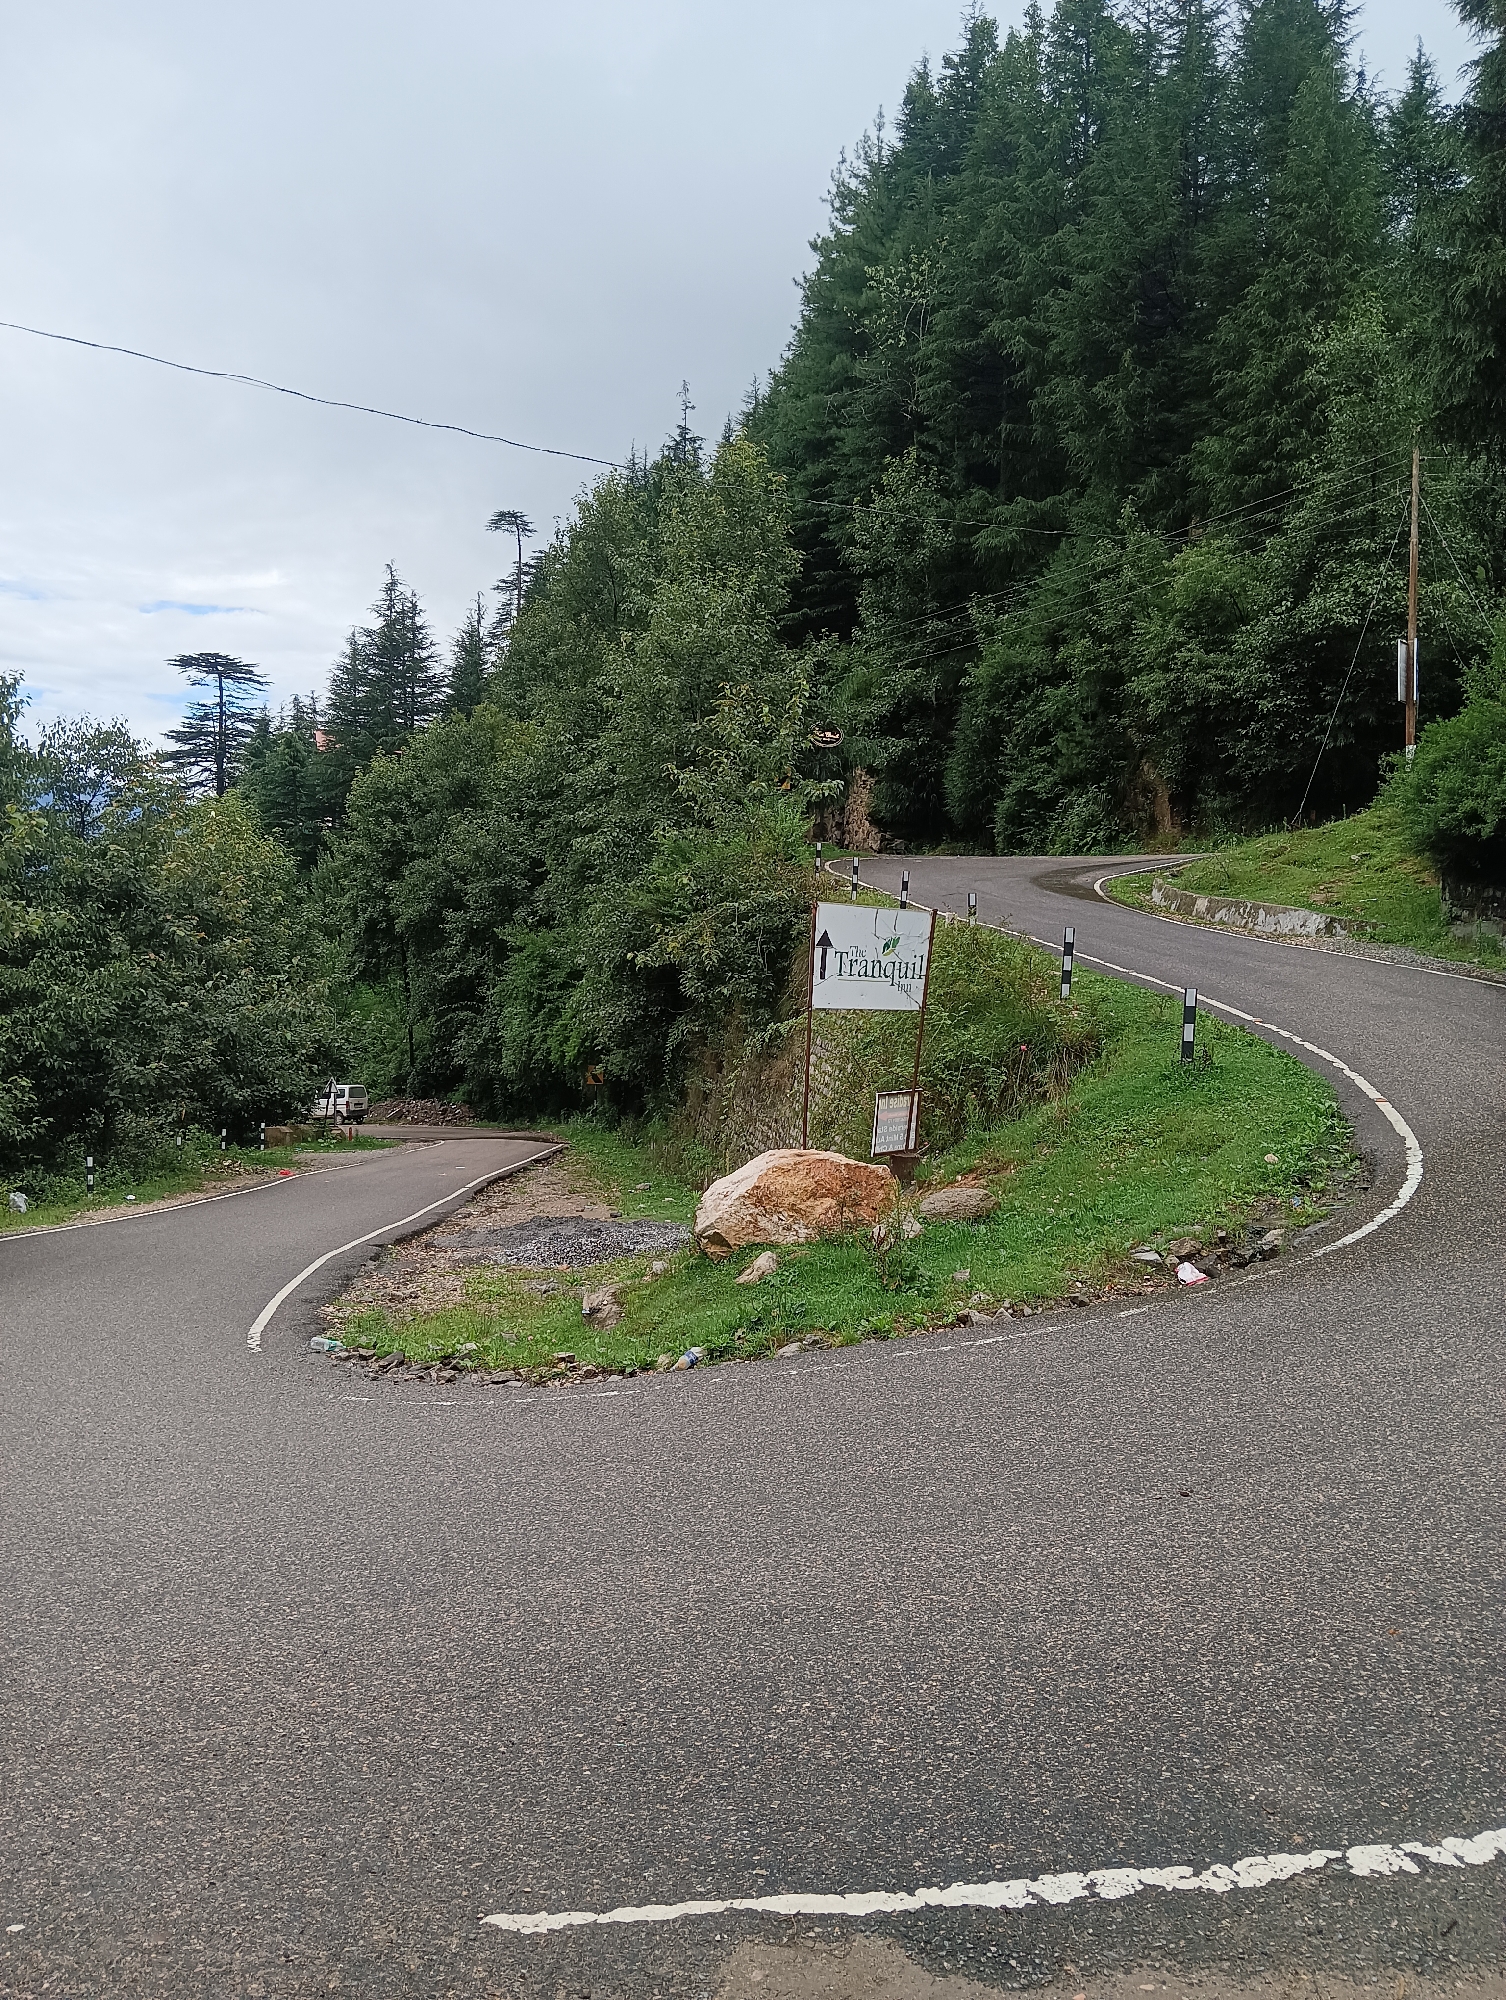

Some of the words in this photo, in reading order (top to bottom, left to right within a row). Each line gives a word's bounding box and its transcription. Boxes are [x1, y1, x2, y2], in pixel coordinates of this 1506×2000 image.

[850, 946, 867, 958] The
[834, 951, 925, 986] Tranquil
[897, 981, 912, 993] Inn
